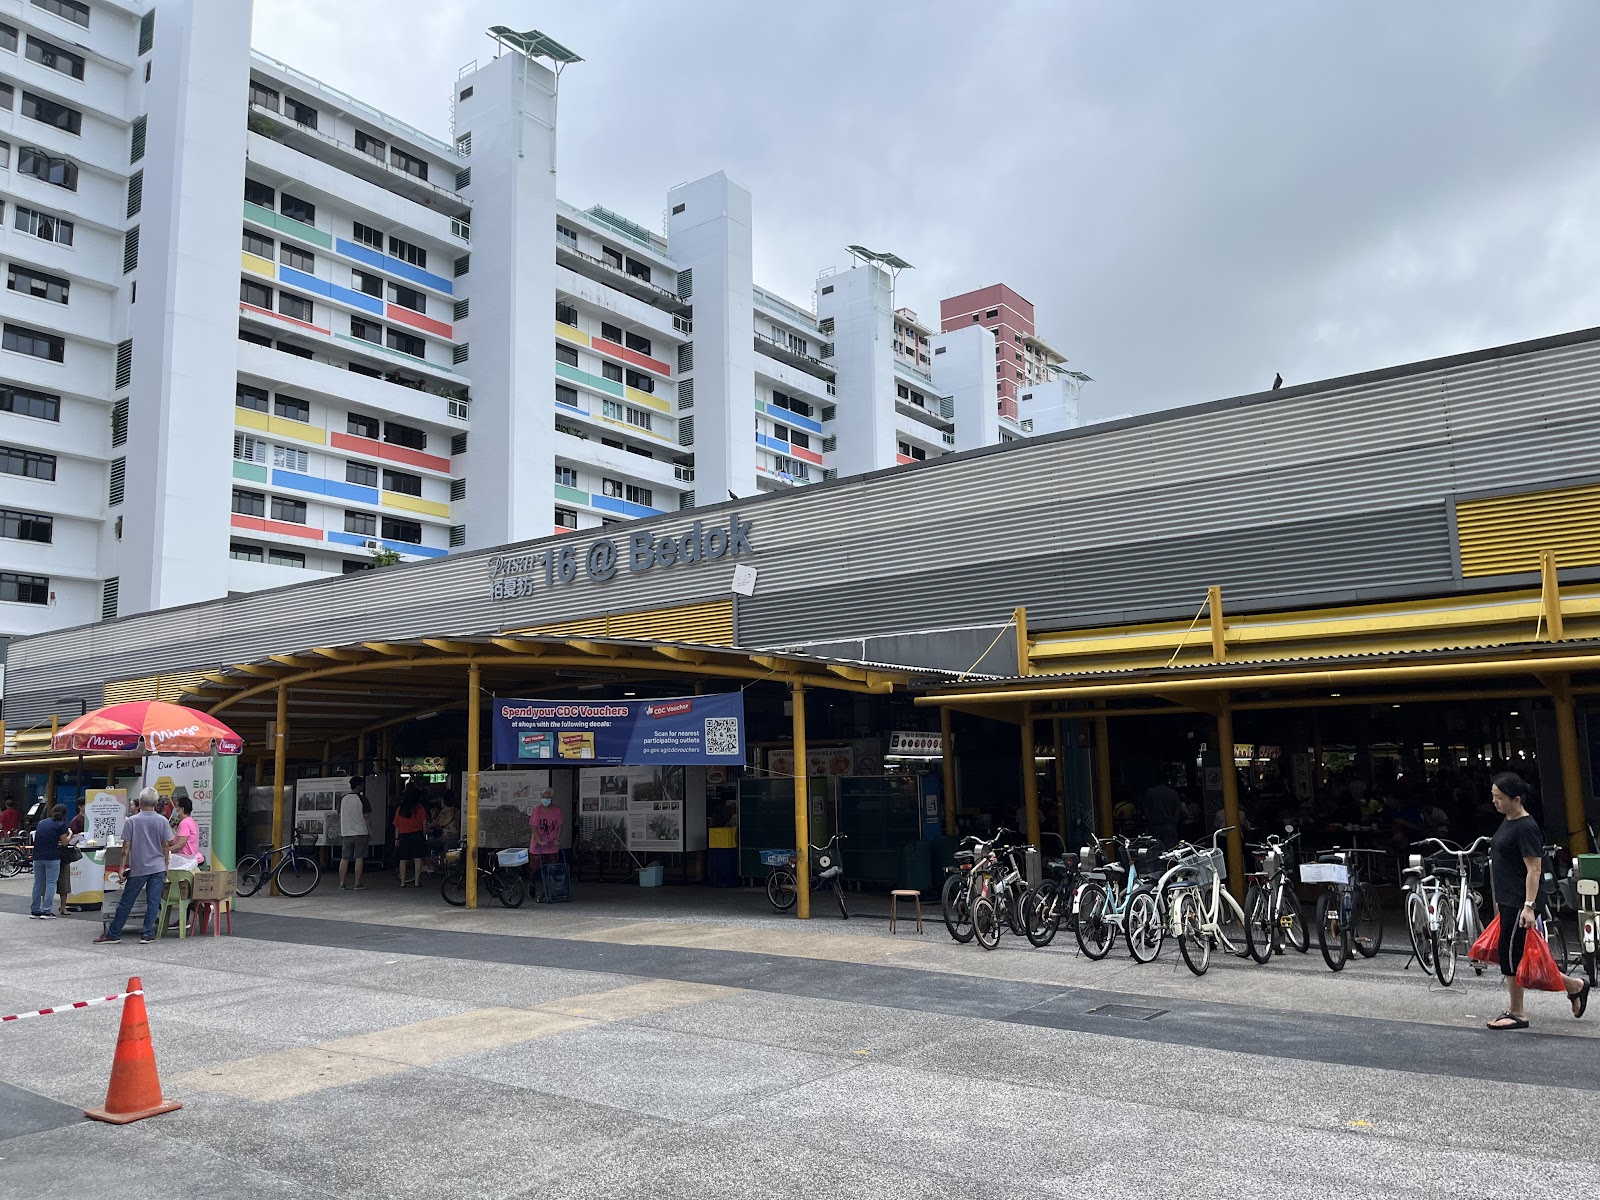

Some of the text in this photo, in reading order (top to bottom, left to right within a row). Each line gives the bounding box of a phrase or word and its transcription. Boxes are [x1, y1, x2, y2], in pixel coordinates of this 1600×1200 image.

[487, 513, 753, 587] Pasar 16 @ Bedok
[502, 706, 629, 720] Spend your CDC Vouchers
[666, 704, 688, 712] Voucher
[86, 736, 124, 748] Mingo
[150, 726, 200, 750] Mingo
[158, 761, 173, 769] Our
[176, 760, 190, 769] East
[192, 759, 207, 768] Coast
